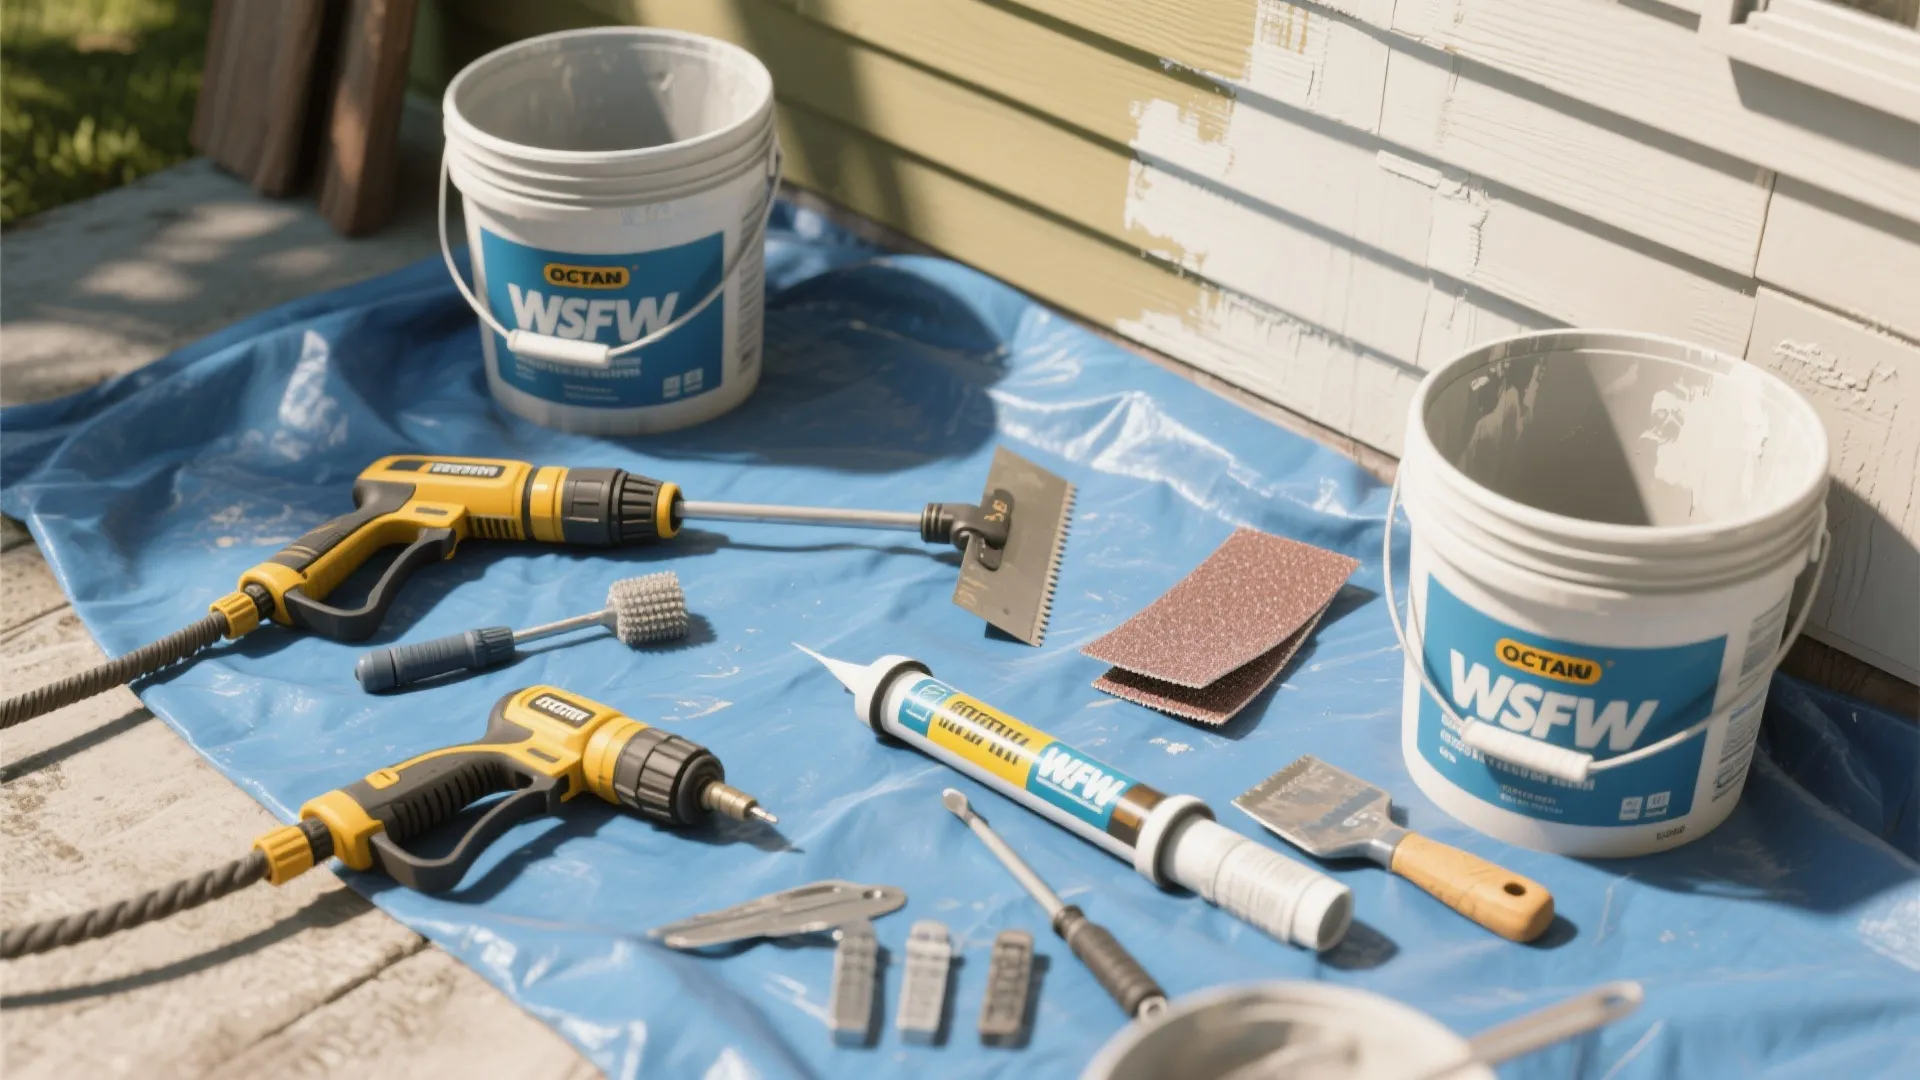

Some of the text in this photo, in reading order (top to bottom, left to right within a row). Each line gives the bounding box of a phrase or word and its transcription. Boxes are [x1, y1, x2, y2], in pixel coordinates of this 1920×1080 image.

[550, 267, 622, 285] OCTAN
[507, 283, 680, 342] WSFW
[1450, 648, 1660, 751] WSFW
[1035, 746, 1127, 807] WFW
